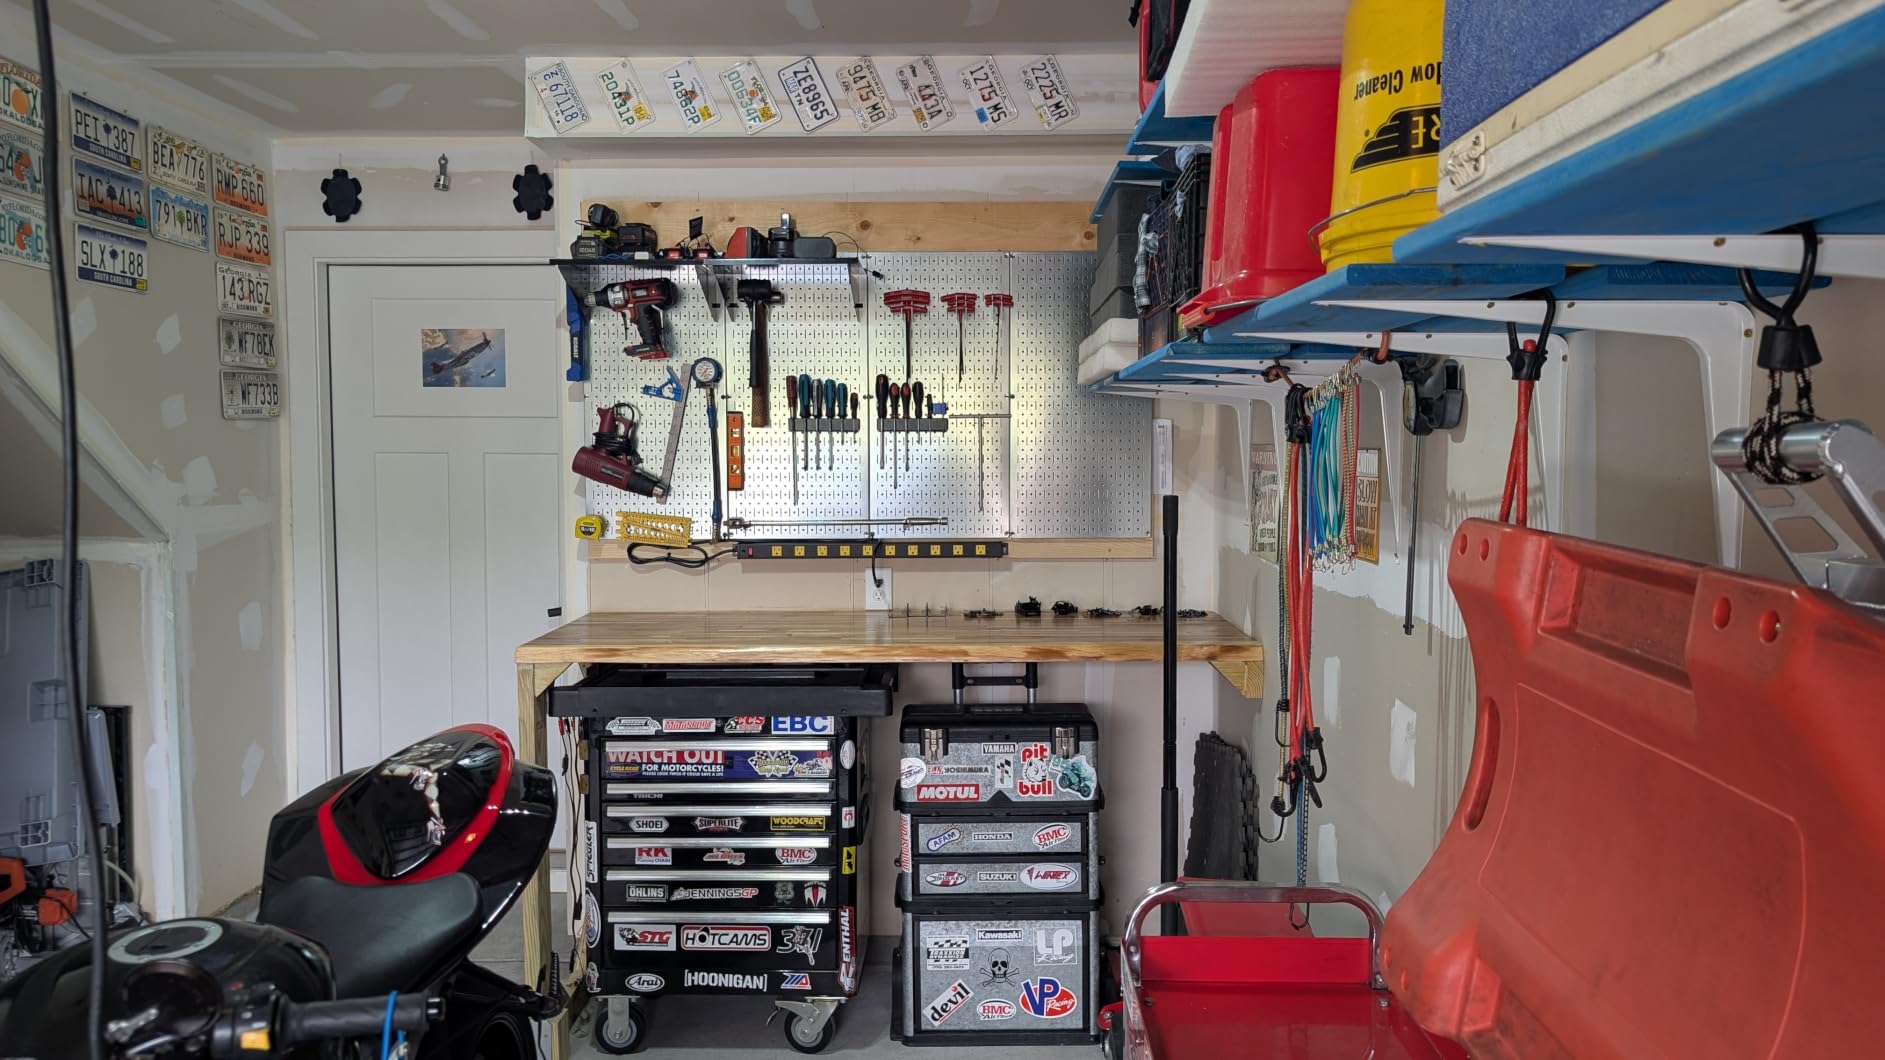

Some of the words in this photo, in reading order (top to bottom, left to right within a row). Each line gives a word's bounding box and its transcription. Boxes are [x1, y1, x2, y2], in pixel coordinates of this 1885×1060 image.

[864, 63, 886, 101] GEORGIA
[925, 63, 947, 101] GEORGIA
[986, 63, 1008, 101] GEORGIA
[1048, 61, 1070, 99] GEORGIA
[1354, 69, 1404, 100] Cleaner
[547, 79, 579, 123] 67118
[599, 69, 636, 128] 20431P
[792, 64, 831, 122] ZE8965
[793, 92, 805, 106] TN
[846, 62, 876, 103] 9475
[865, 100, 886, 124] MB
[968, 64, 998, 103] 1275
[985, 101, 1007, 124] MS
[1029, 60, 1060, 102] 2225
[1047, 98, 1069, 122] MR
[75, 109, 100, 143] PEI
[113, 125, 135, 156] 387
[153, 141, 175, 172] BEA
[184, 153, 205, 181] 776
[77, 173, 104, 204] IAC
[118, 186, 142, 215] 413
[216, 168, 238, 196] RMP
[241, 177, 266, 207] 660
[156, 200, 176, 227] 791
[186, 209, 207, 236] BKR
[218, 222, 241, 250] RJP
[245, 230, 269, 256] 339
[81, 240, 106, 270] SLX
[120, 249, 144, 278] 188
[218, 266, 252, 279] GEORGIA
[222, 275, 245, 301] 143
[248, 280, 271, 305] RGZ
[238, 331, 276, 358] WF78EK
[241, 382, 279, 406] WF733B
[1358, 478, 1377, 504] SLOW
[773, 716, 828, 732] EBC
[984, 745, 1014, 753] YAMAHA
[1021, 743, 1049, 762] pit
[642, 764, 659, 772] FOR
[663, 764, 724, 773] MOTORCYCLES!
[944, 766, 989, 774] YOSHIMURA
[919, 787, 978, 799] MOTUL
[1019, 780, 1053, 796] bull
[635, 820, 663, 829] SHOEI
[700, 817, 739, 828] SUPERLITE
[772, 816, 824, 825] WOODCRAFT
[934, 831, 957, 847] AFAM
[1038, 827, 1067, 843] BMC
[638, 848, 668, 857] RK
[781, 848, 811, 858] BMC
[980, 873, 1016, 881] SUZUKI
[629, 886, 664, 898] ÖHLINS
[639, 930, 672, 944] STG
[684, 930, 768, 946] HOTCAMS
[978, 930, 1022, 939] Kawasaki
[1037, 928, 1074, 955] LP
[1036, 953, 1074, 963] Racing
[635, 976, 659, 988] Arai
[931, 982, 971, 1023] devil
[1022, 978, 1060, 1017] VP
[1047, 999, 1075, 1011] Racing
[982, 1005, 1012, 1015] BMC
